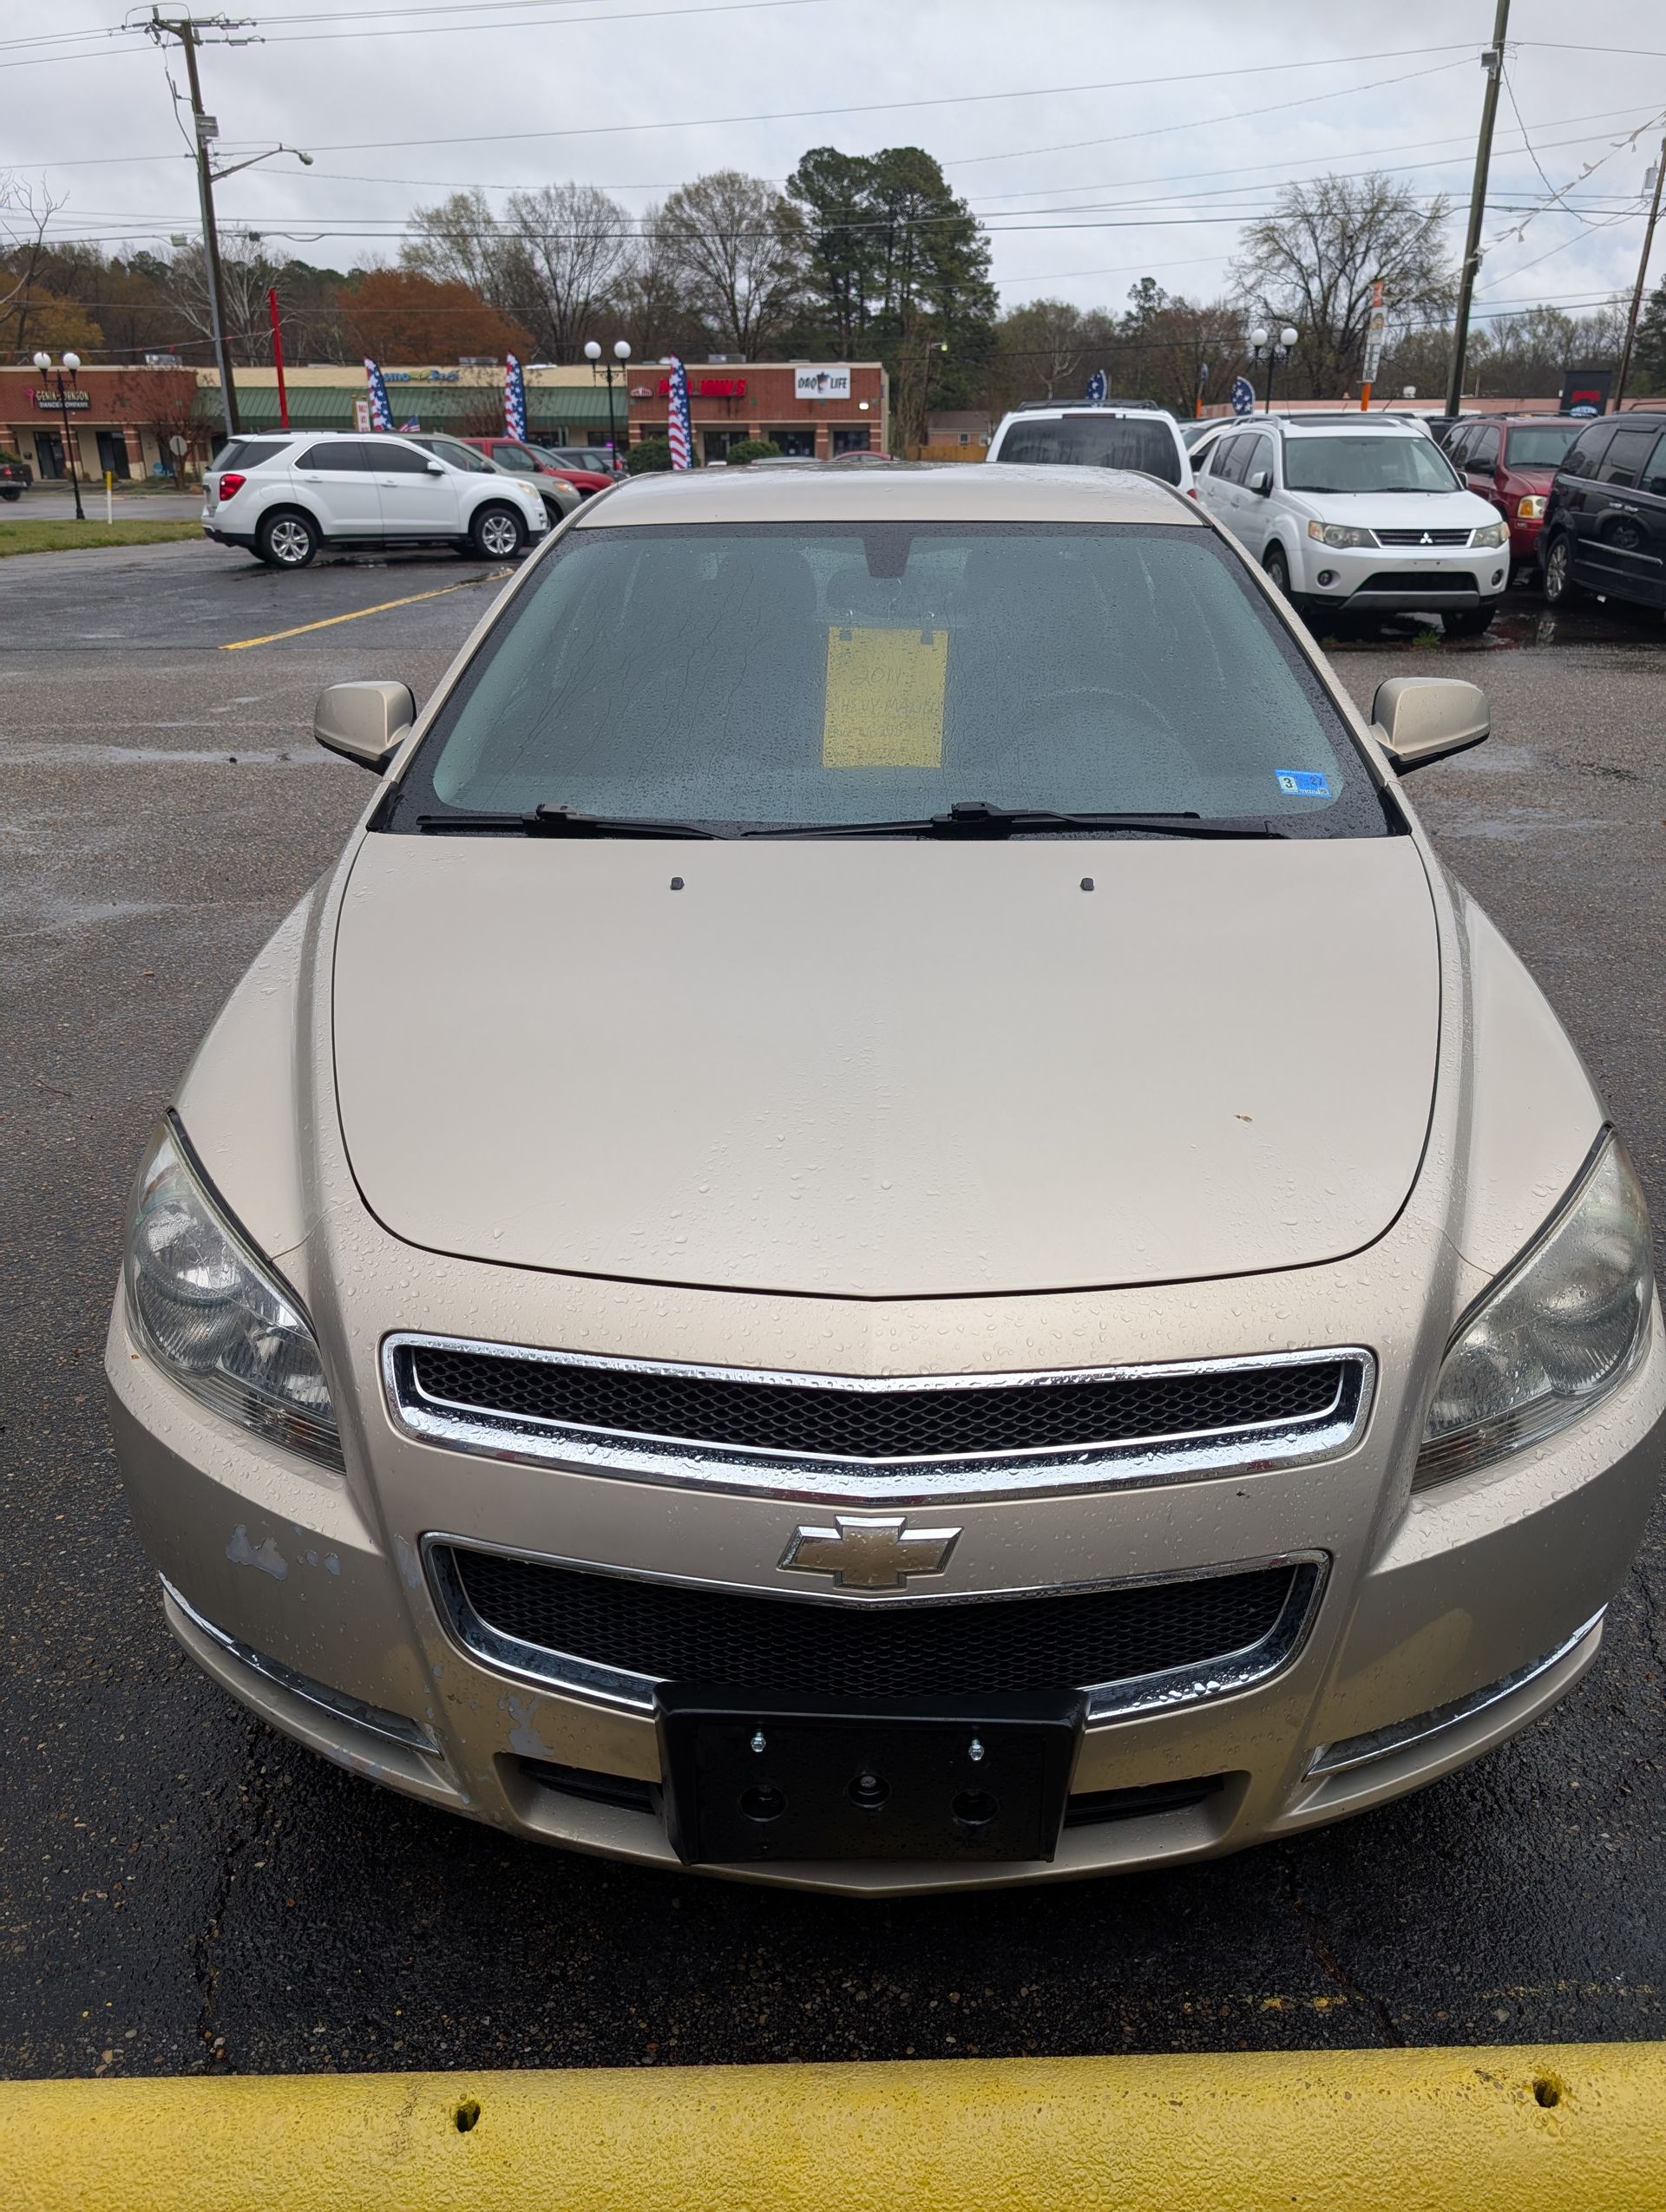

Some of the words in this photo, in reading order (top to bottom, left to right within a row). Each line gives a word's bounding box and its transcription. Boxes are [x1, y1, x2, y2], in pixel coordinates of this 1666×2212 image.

[830, 377, 848, 389] LIFE
[850, 666, 902, 687] 2011
[1283, 777, 1293, 789] 3
